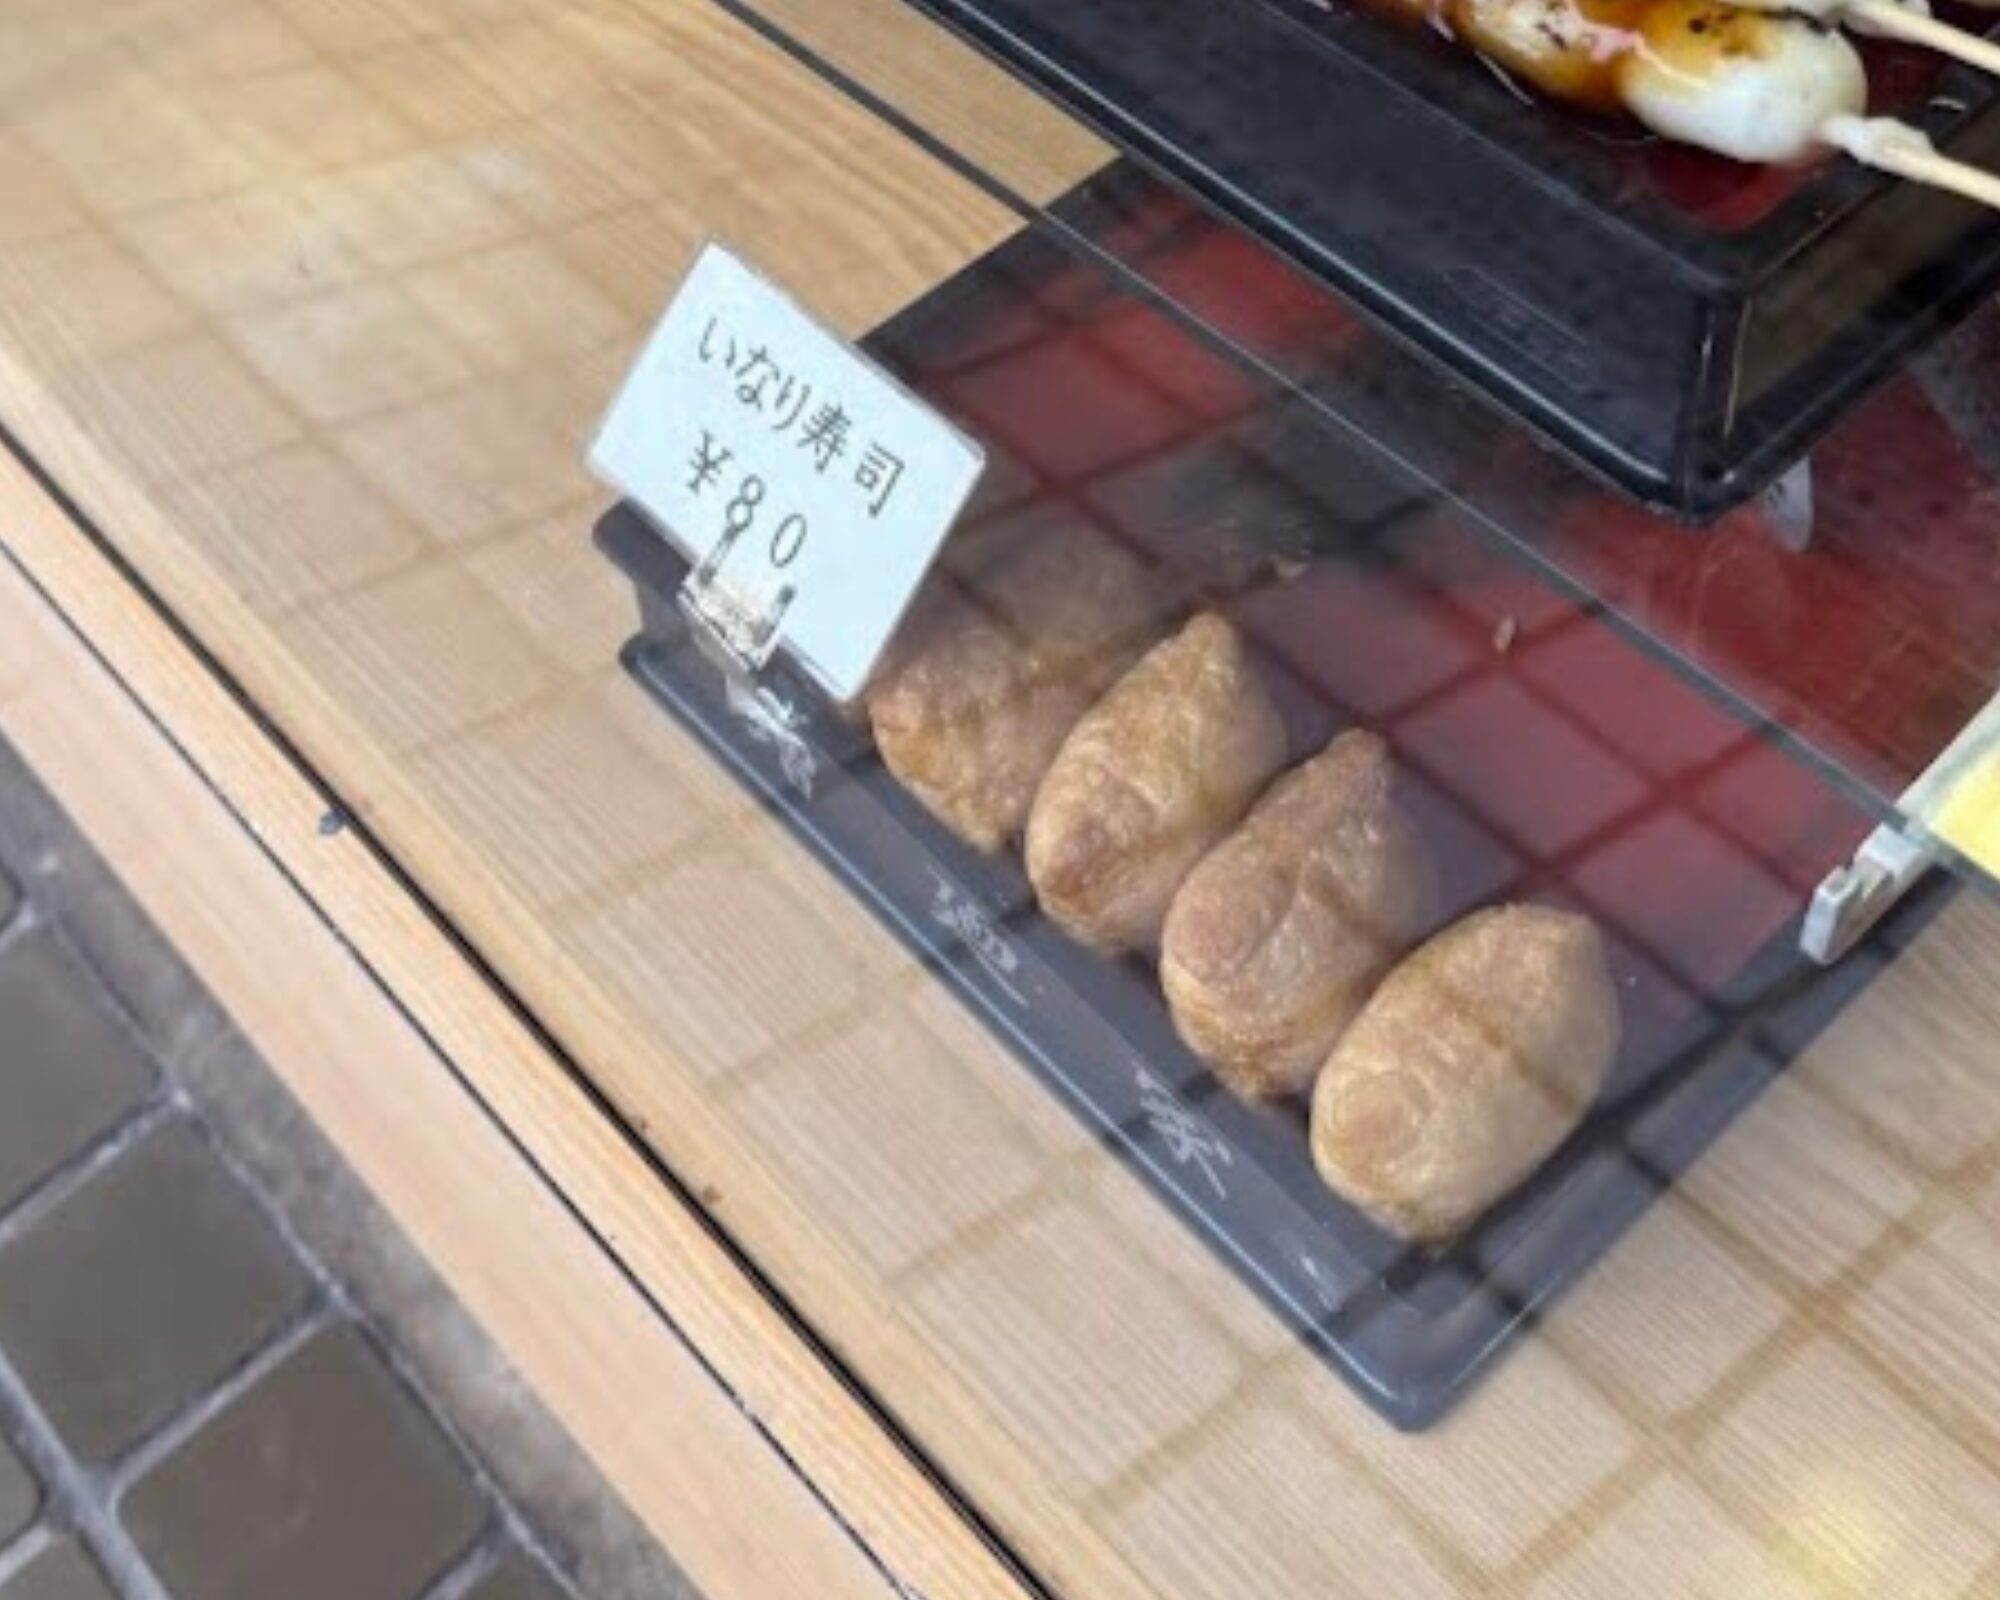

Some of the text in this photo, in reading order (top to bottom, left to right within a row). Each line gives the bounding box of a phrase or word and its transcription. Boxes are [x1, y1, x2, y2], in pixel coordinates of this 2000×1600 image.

[686, 429, 808, 568] ¥80
[698, 316, 905, 519] いなり寿司
